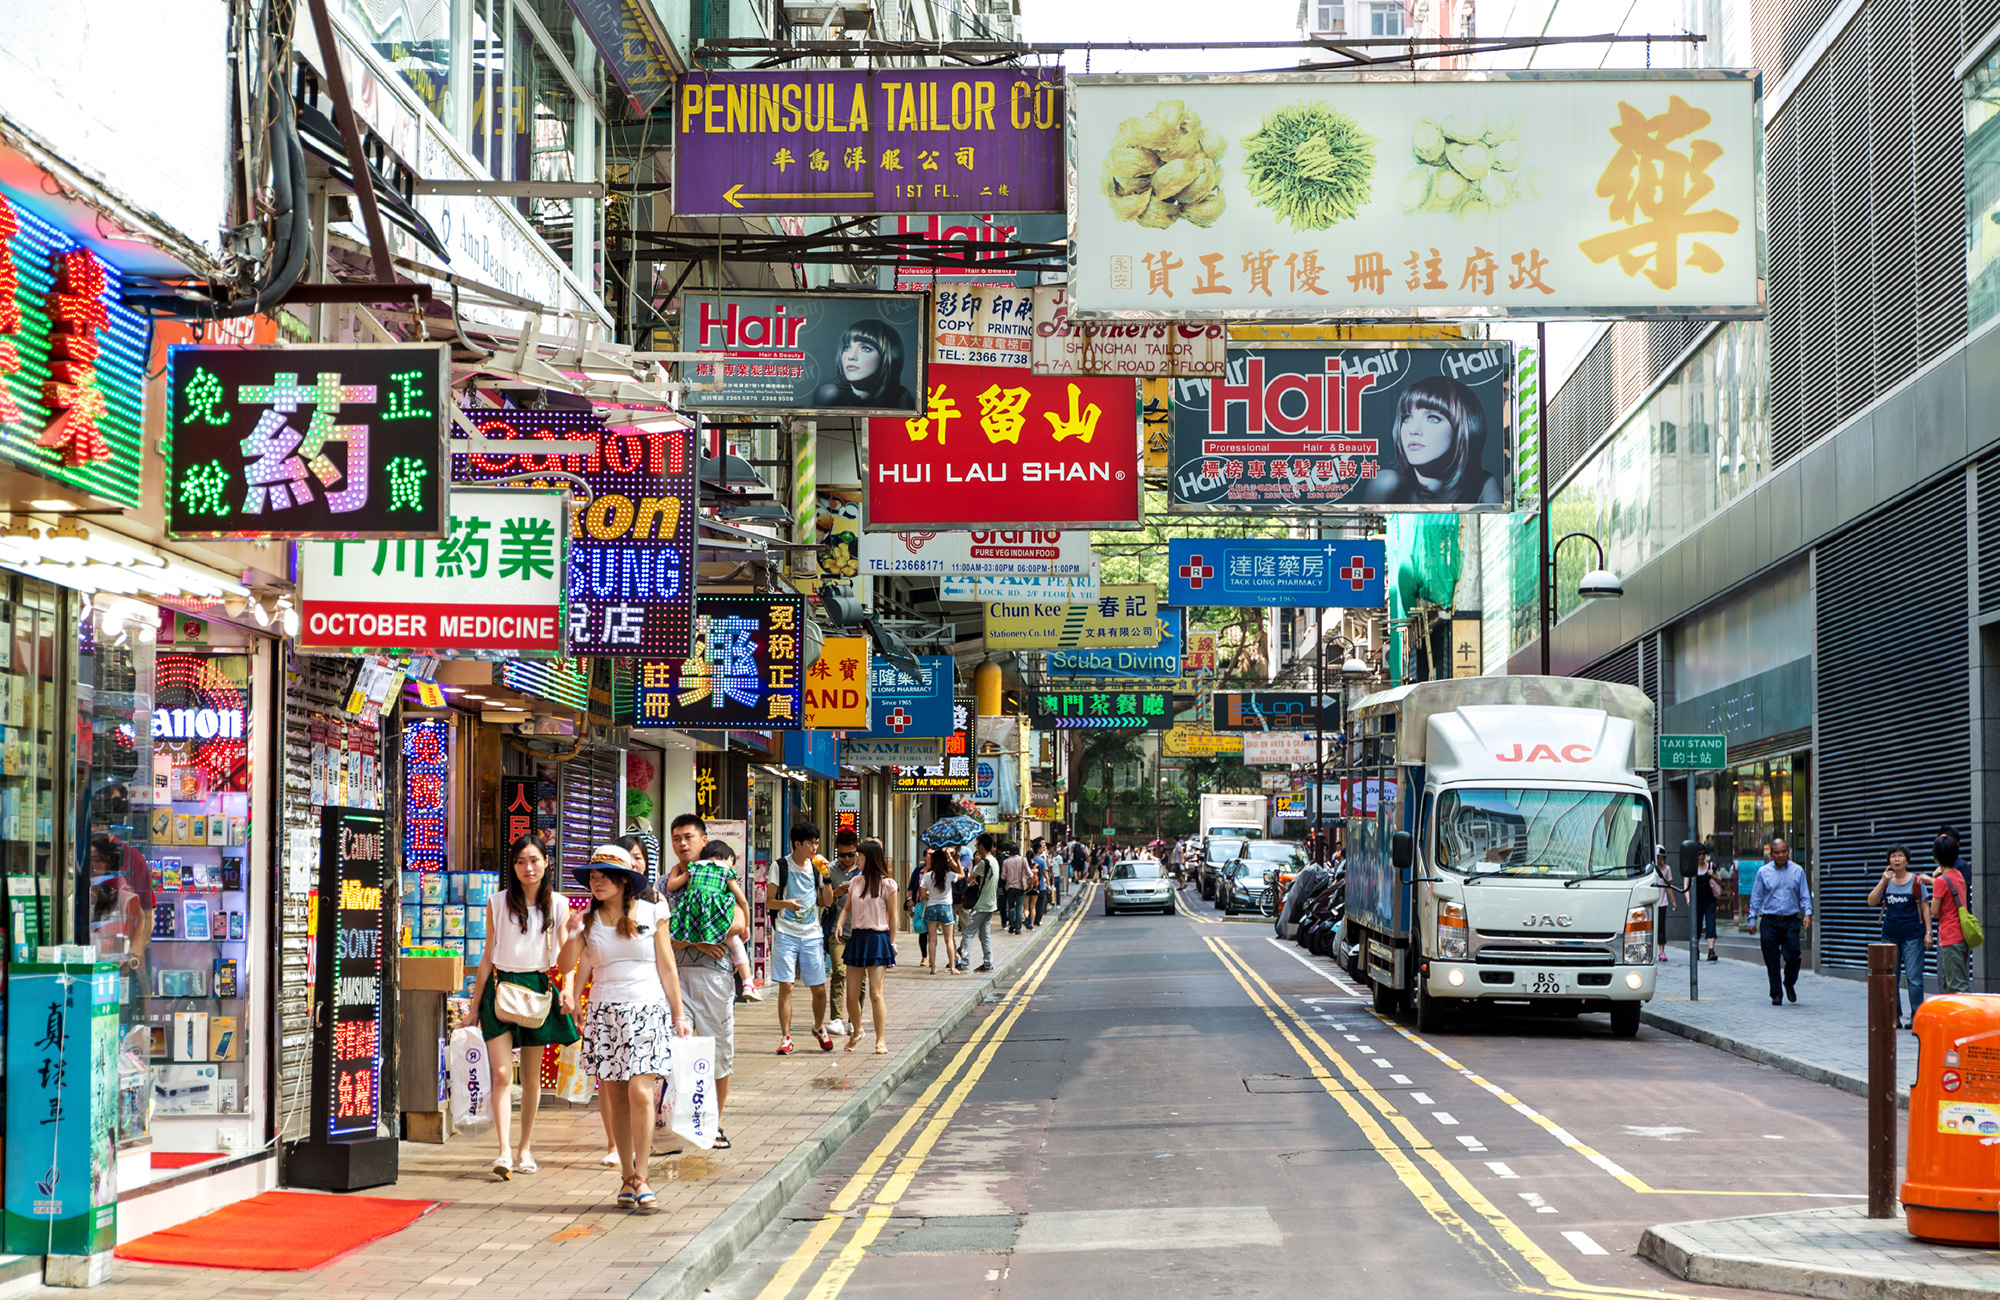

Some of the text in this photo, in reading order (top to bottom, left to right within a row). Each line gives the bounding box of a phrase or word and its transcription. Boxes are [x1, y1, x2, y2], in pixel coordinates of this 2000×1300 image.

[682, 80, 1062, 134] PENINSULA TAILOR CO.
[771, 146, 975, 173] 半島洋服公司
[895, 185, 923, 198] 1ST
[1578, 95, 1740, 290] 藥
[897, 215, 1018, 262] Hair
[935, 291, 983, 320] 影印
[700, 302, 807, 348] Hair
[938, 320, 975, 331] COPY
[938, 350, 1028, 364] TEL: 2366 7738
[1066, 343, 1193, 356] SHANGHAI TAILOR
[1052, 360, 1072, 371] 7-A
[1077, 360, 1112, 371] LOCK
[1117, 361, 1155, 372] ROAD
[1180, 361, 1224, 373] FLOOR
[1447, 348, 1500, 379] Hair
[1209, 356, 1377, 434] Hair
[905, 382, 1102, 445] 許留山
[468, 421, 684, 474] Canon
[1303, 443, 1323, 452] Hair
[1329, 444, 1336, 452] &
[1338, 443, 1372, 454] Beauty
[879, 461, 1110, 482] HUI LAU SHAN
[1202, 459, 1381, 479] 標榜專業髮型設計
[975, 548, 1055, 558] PURE VEG INDIAN FOOD
[1230, 555, 1324, 577] 達隆藥房
[978, 588, 1003, 596] LOCK
[1008, 589, 1022, 597] RD.
[1047, 577, 1096, 588] PEARL
[1230, 578, 1322, 587] TACK LONG PHARMACY
[990, 602, 1062, 617] Chun Kee
[1097, 595, 1148, 618] 春記
[309, 612, 554, 639] OCTOBER MEDICINE
[989, 628, 1058, 639] Stationery Co. Ltd.
[1085, 626, 1153, 639] 文具有限公司
[1053, 651, 1112, 670] Scuba
[1118, 652, 1176, 673] Diving
[151, 708, 243, 738] anon
[903, 746, 936, 754] PEARL
[1496, 743, 1593, 763] JAC
[1662, 739, 1722, 748] TAXI STAND
[1672, 752, 1712, 764] 的士站
[898, 779, 970, 787] CHIU FAT RESTAURANT
[341, 827, 382, 862] Canon
[340, 879, 382, 911] Nikon
[1522, 913, 1573, 928] JAC
[338, 928, 380, 960] SONY
[1532, 982, 1561, 994] 220
[1537, 972, 1556, 984] BS
[336, 975, 378, 1006] SAMSUNG
[337, 1069, 372, 1119] 免稅
